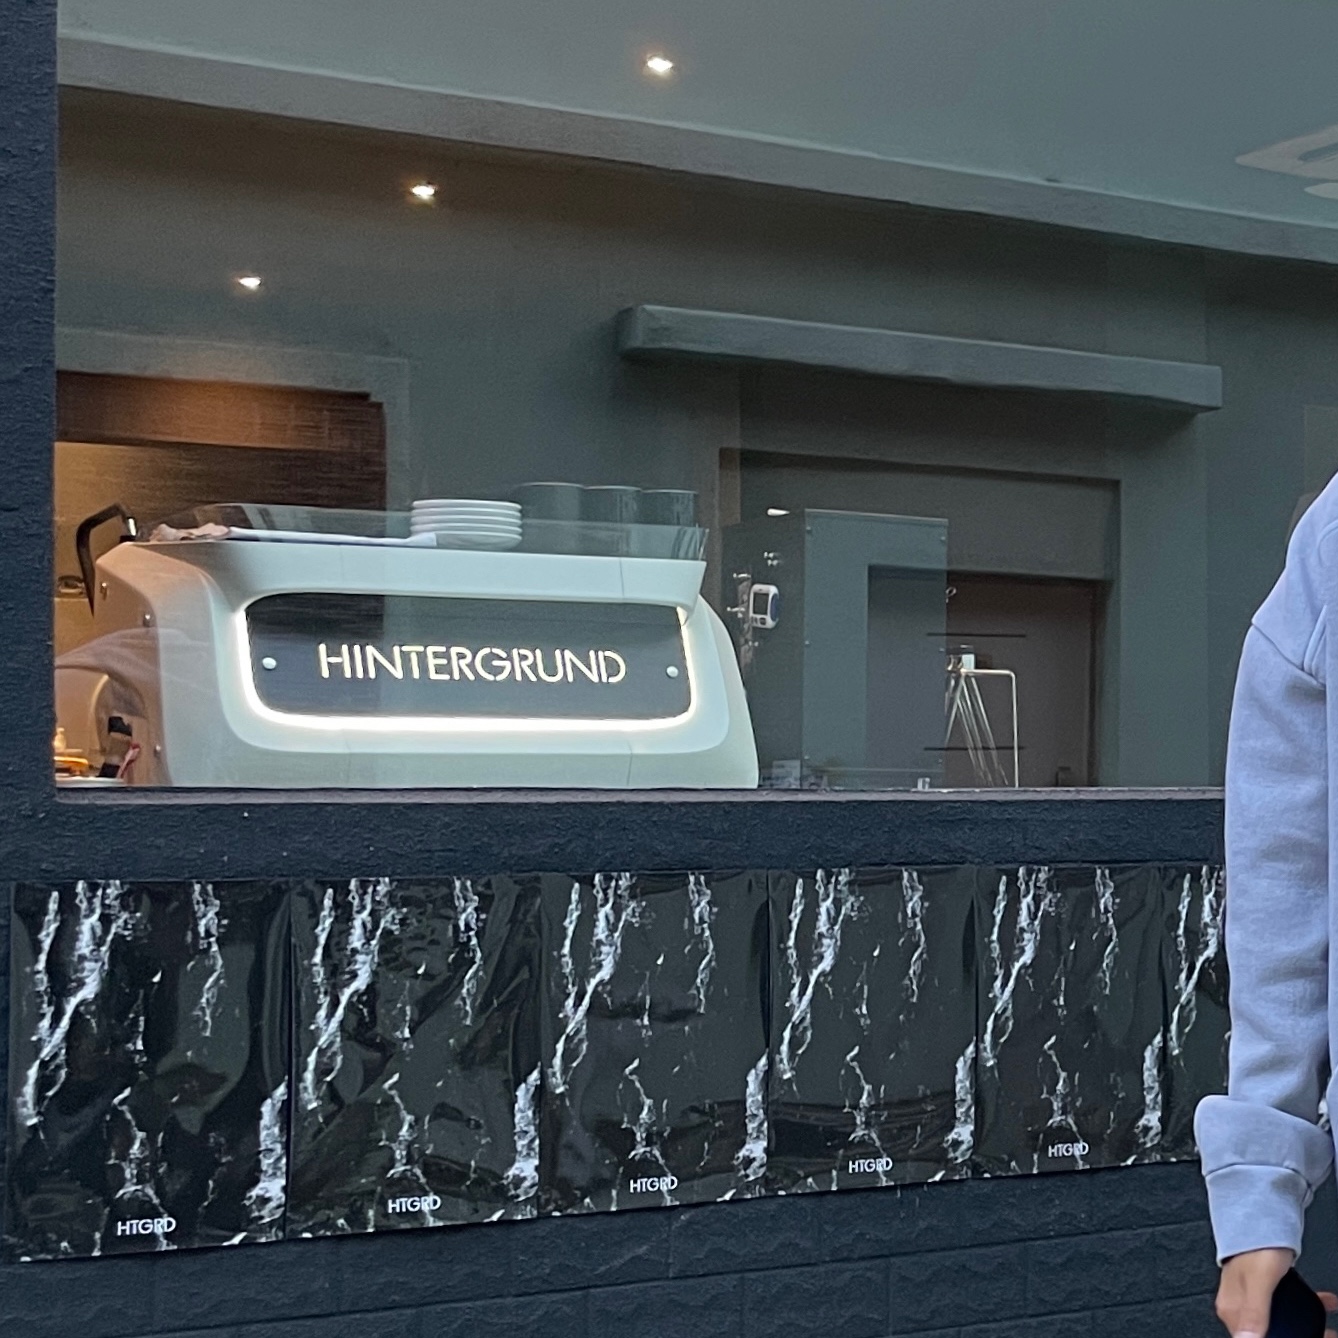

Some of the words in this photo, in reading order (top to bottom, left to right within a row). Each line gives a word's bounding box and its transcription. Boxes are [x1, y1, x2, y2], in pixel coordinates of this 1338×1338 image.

[318, 643, 628, 683] HINTERGRUND
[629, 1176, 679, 1193] HTGRD
[387, 1195, 442, 1214] HTGRD
[116, 1216, 177, 1236] HTGRD
